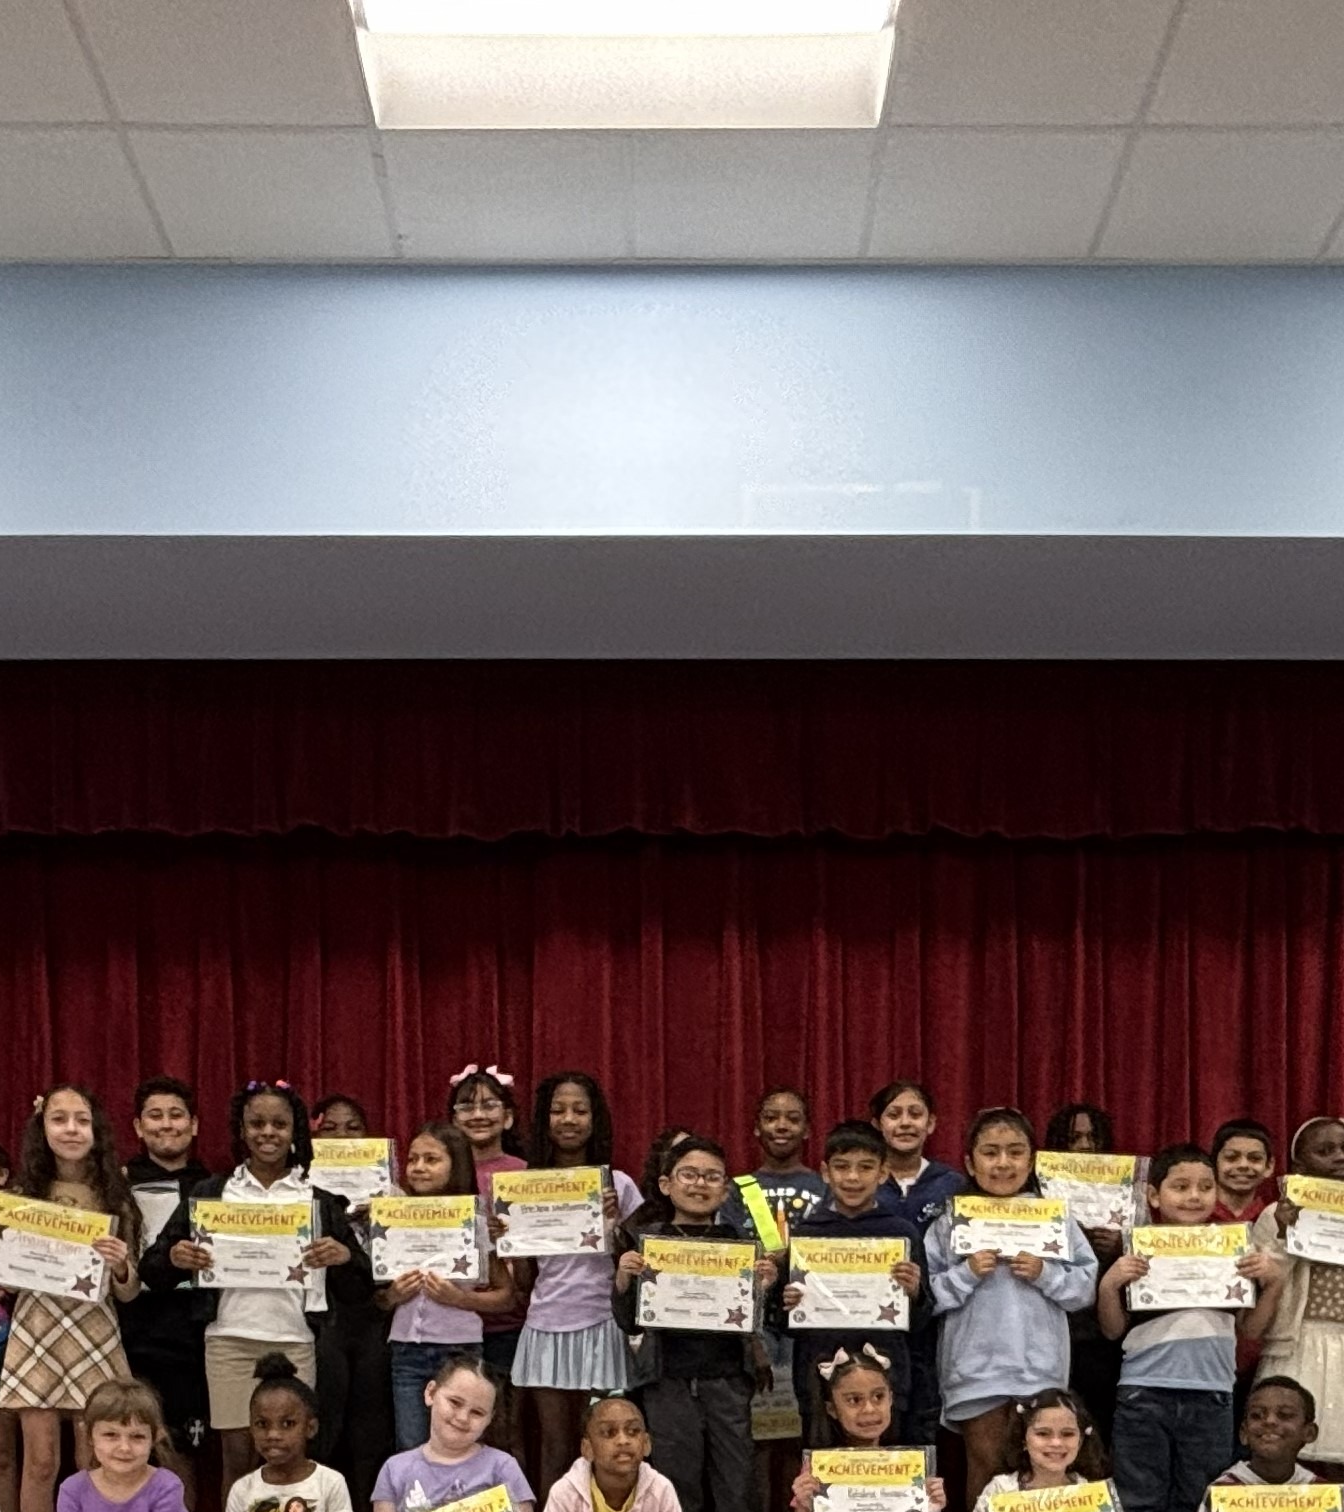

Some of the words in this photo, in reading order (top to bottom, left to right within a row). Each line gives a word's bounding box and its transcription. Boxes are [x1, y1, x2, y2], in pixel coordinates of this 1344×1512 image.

[508, 1181, 586, 1194] ACHIEVEMENT
[212, 1213, 295, 1225] ACHIEVEMENT
[387, 1208, 461, 1220] ACHIEVEMENT
[6, 1209, 94, 1236] ACHIEVEMENT
[657, 1251, 739, 1269] ACHIEVEMENT
[807, 1252, 890, 1265] ACHIEVEMENT
[828, 1463, 910, 1476] ACHIEVEMENT
[1230, 1496, 1322, 1508] ACHIEVEMENT
